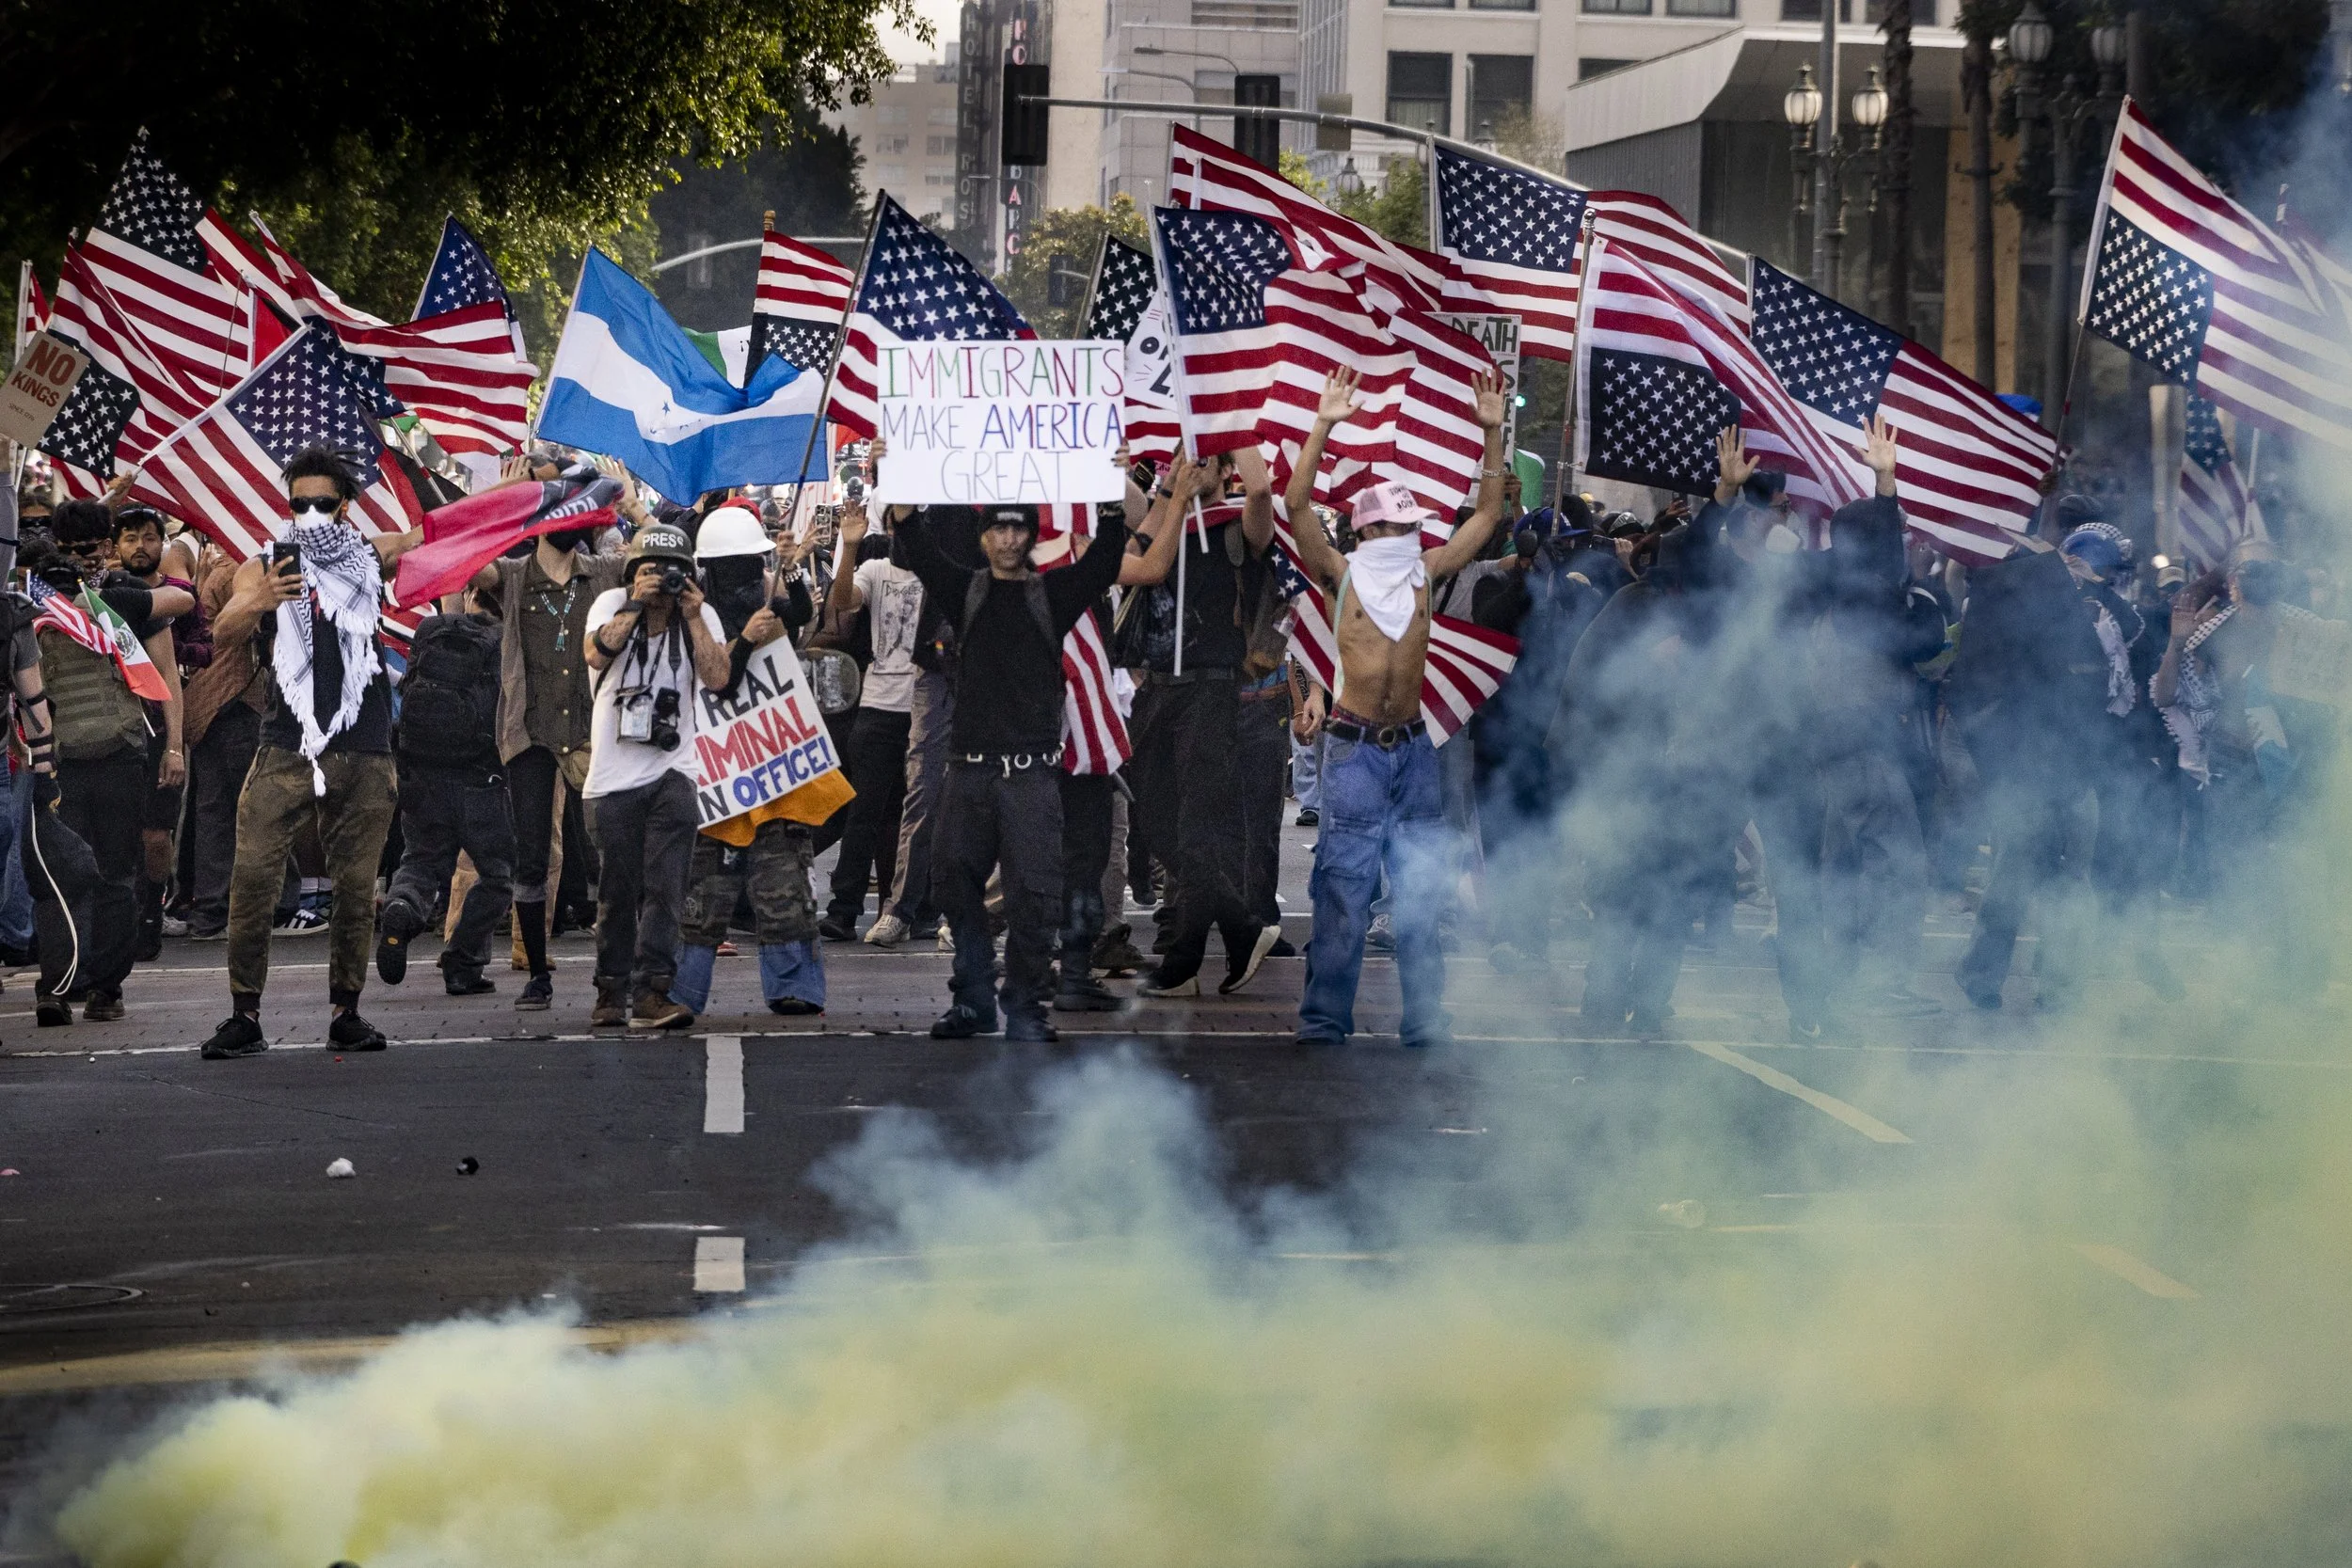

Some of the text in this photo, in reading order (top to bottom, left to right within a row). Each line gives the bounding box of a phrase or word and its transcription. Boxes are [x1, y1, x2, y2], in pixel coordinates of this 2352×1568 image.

[962, 13, 977, 130] HOTEL
[10, 371, 60, 408] KINGS
[25, 339, 77, 387] NO
[879, 346, 1124, 398] IMMIGRANTS
[882, 402, 1123, 450] MAKE AMERICA
[941, 450, 1070, 504] GREAT
[699, 655, 795, 728] REAL
[695, 695, 818, 787] IMINAL
[732, 736, 834, 807] OFFICE!
